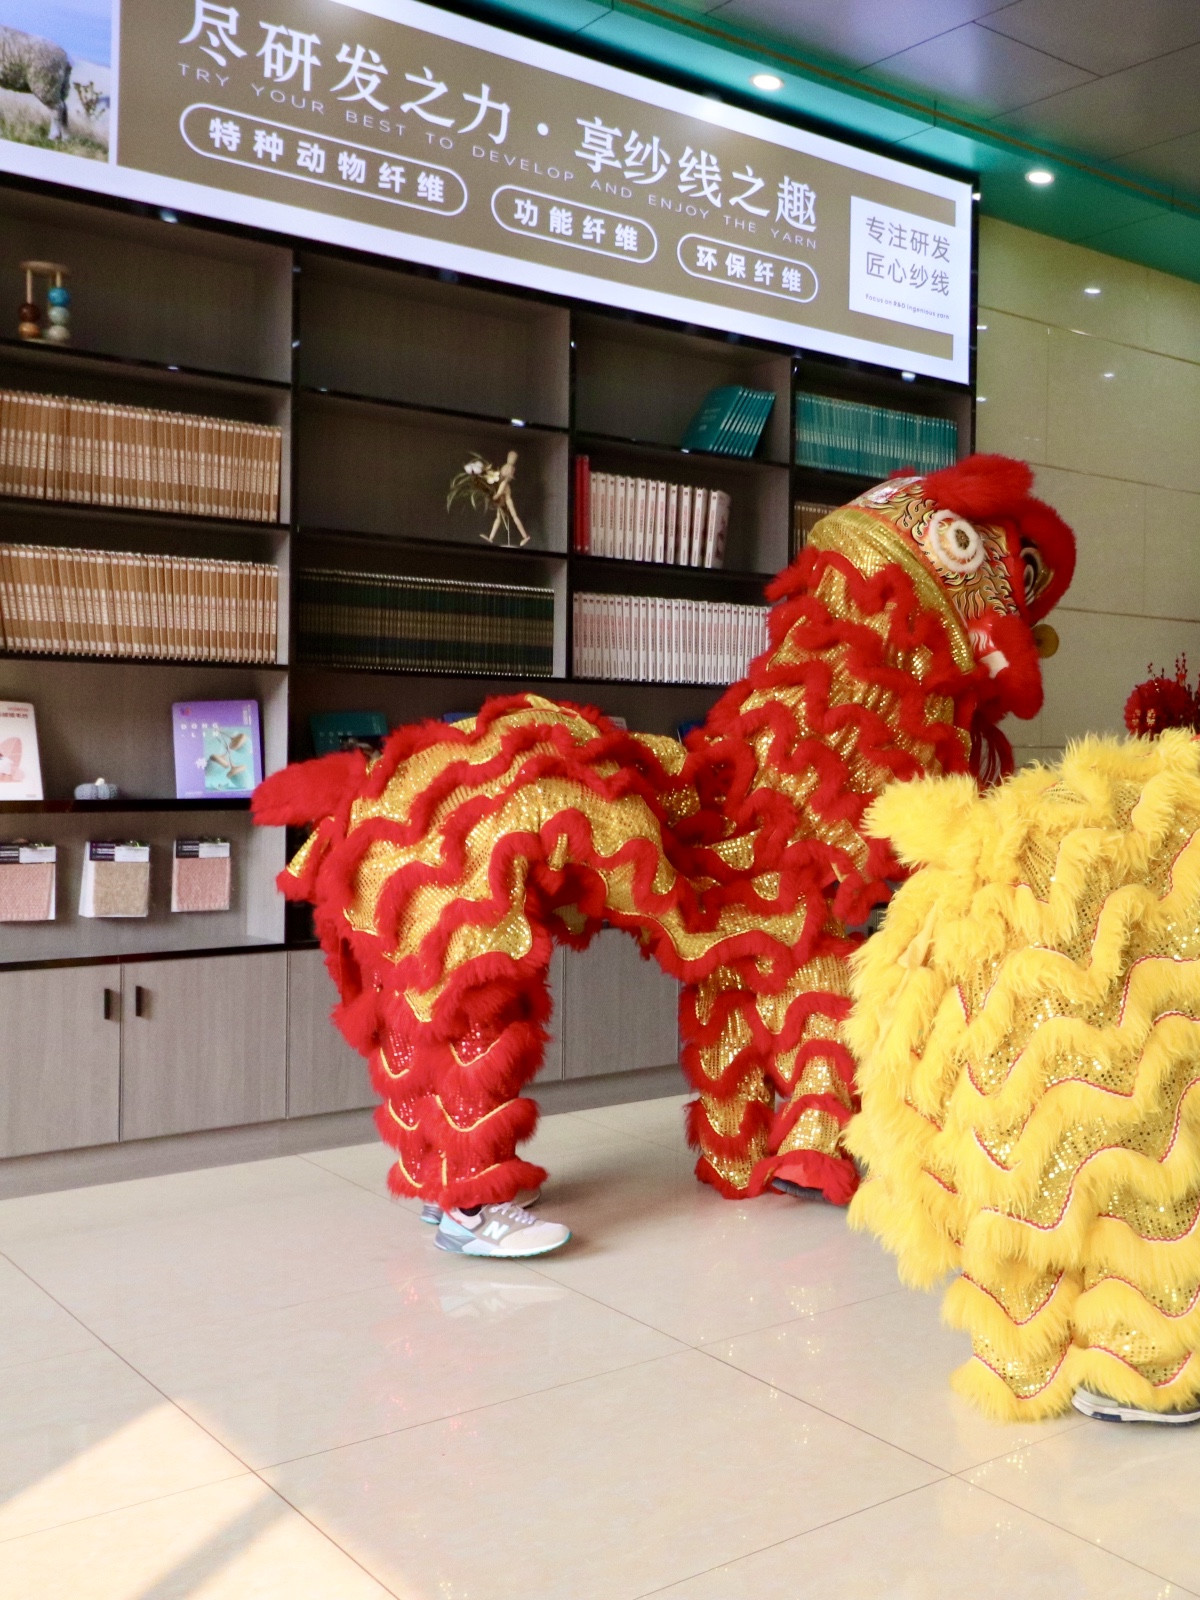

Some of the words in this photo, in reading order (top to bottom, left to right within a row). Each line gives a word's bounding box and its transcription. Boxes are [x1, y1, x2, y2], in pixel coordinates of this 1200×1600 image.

[178, 63, 229, 86] TRY
[251, 83, 324, 114] YOUR
[346, 110, 406, 136] BEST
[426, 132, 454, 149] TO
[472, 145, 574, 182] DEVELOP
[590, 179, 632, 199] AND
[648, 194, 710, 220] ENJOY
[723, 214, 756, 234] THE
[770, 228, 817, 249] YARN
[208, 118, 445, 203] 特种动物纤维
[514, 198, 638, 252] 功能纤维
[865, 216, 950, 263] 专注研发
[696, 245, 801, 292] 环保纤维
[866, 251, 949, 296] 匠心纱线
[865, 293, 883, 304] Focus
